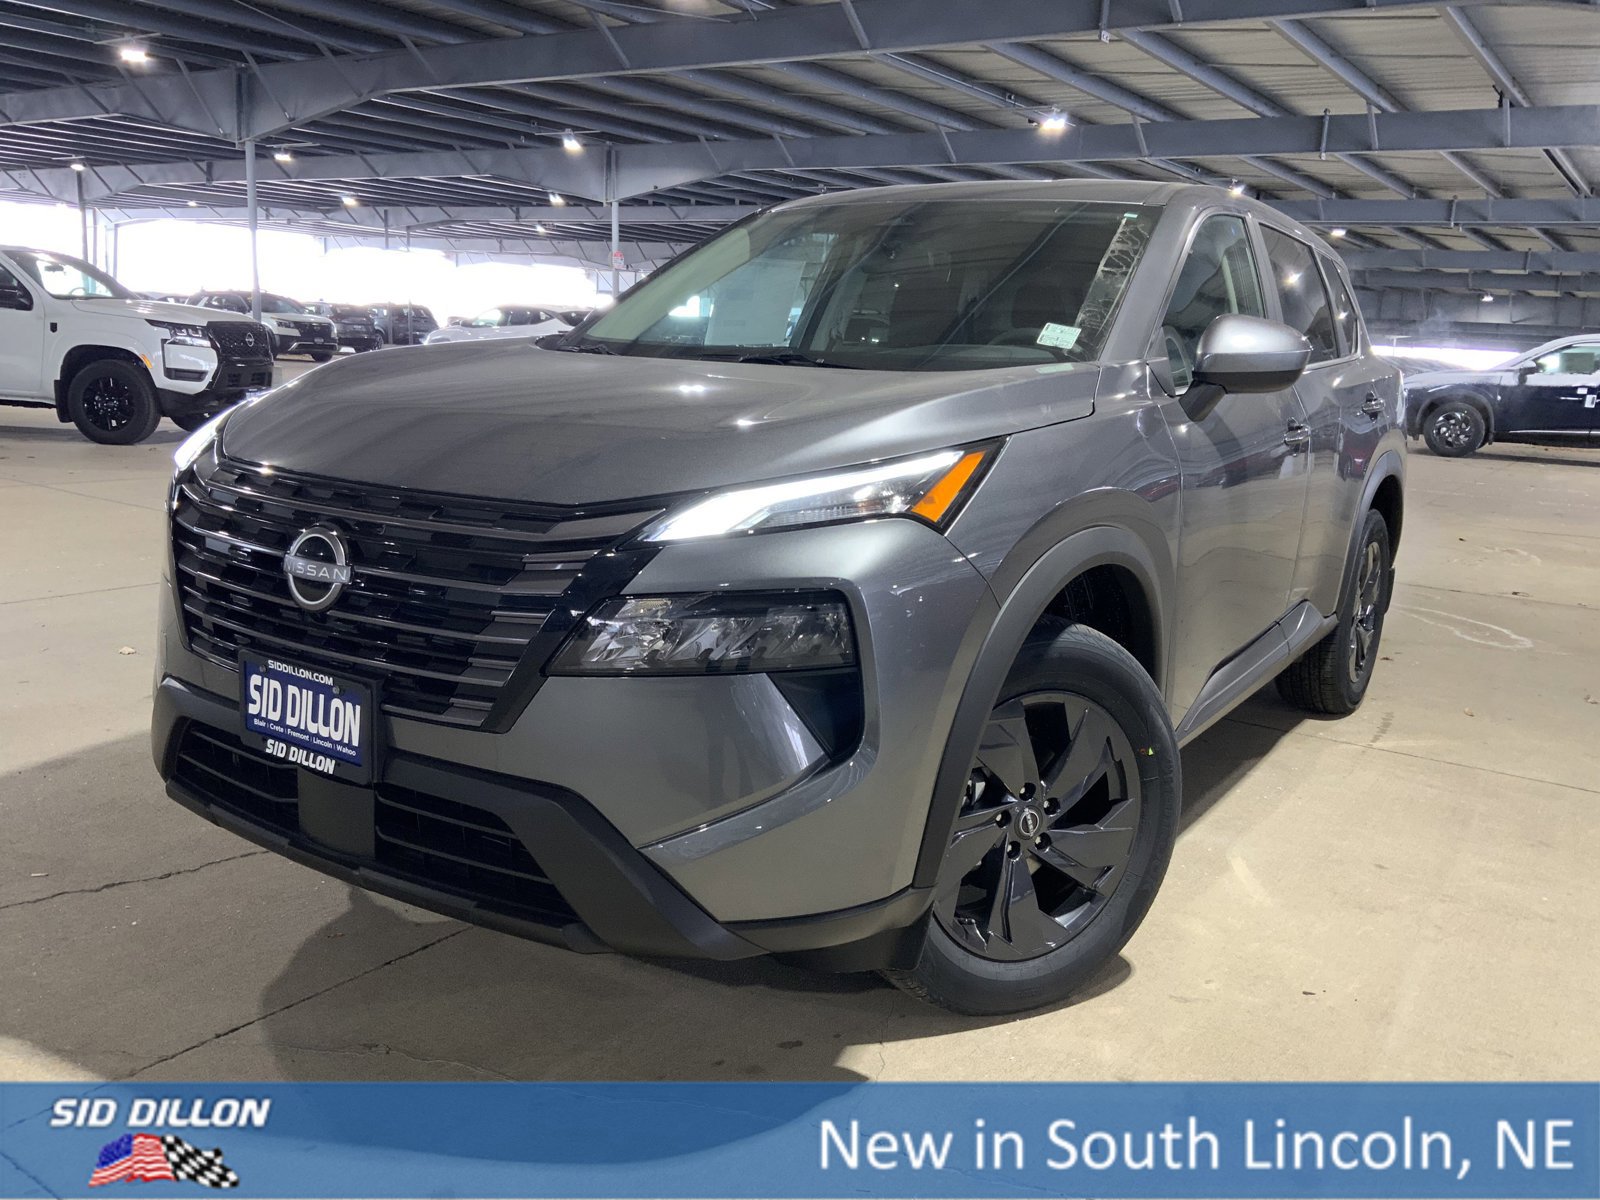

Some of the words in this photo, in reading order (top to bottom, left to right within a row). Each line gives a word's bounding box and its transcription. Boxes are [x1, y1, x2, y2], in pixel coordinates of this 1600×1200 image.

[284, 559, 347, 581] NISSAN
[267, 659, 334, 686] SIDDILLON.COM
[248, 674, 283, 722] SID
[285, 684, 361, 747] DILLON
[253, 718, 266, 727] Blair
[269, 723, 284, 734] Crete
[287, 728, 310, 742] Fremont
[313, 736, 333, 749] Lincoln
[336, 743, 357, 757] Wahoo
[265, 738, 287, 758] SID
[288, 746, 336, 775] DILLON
